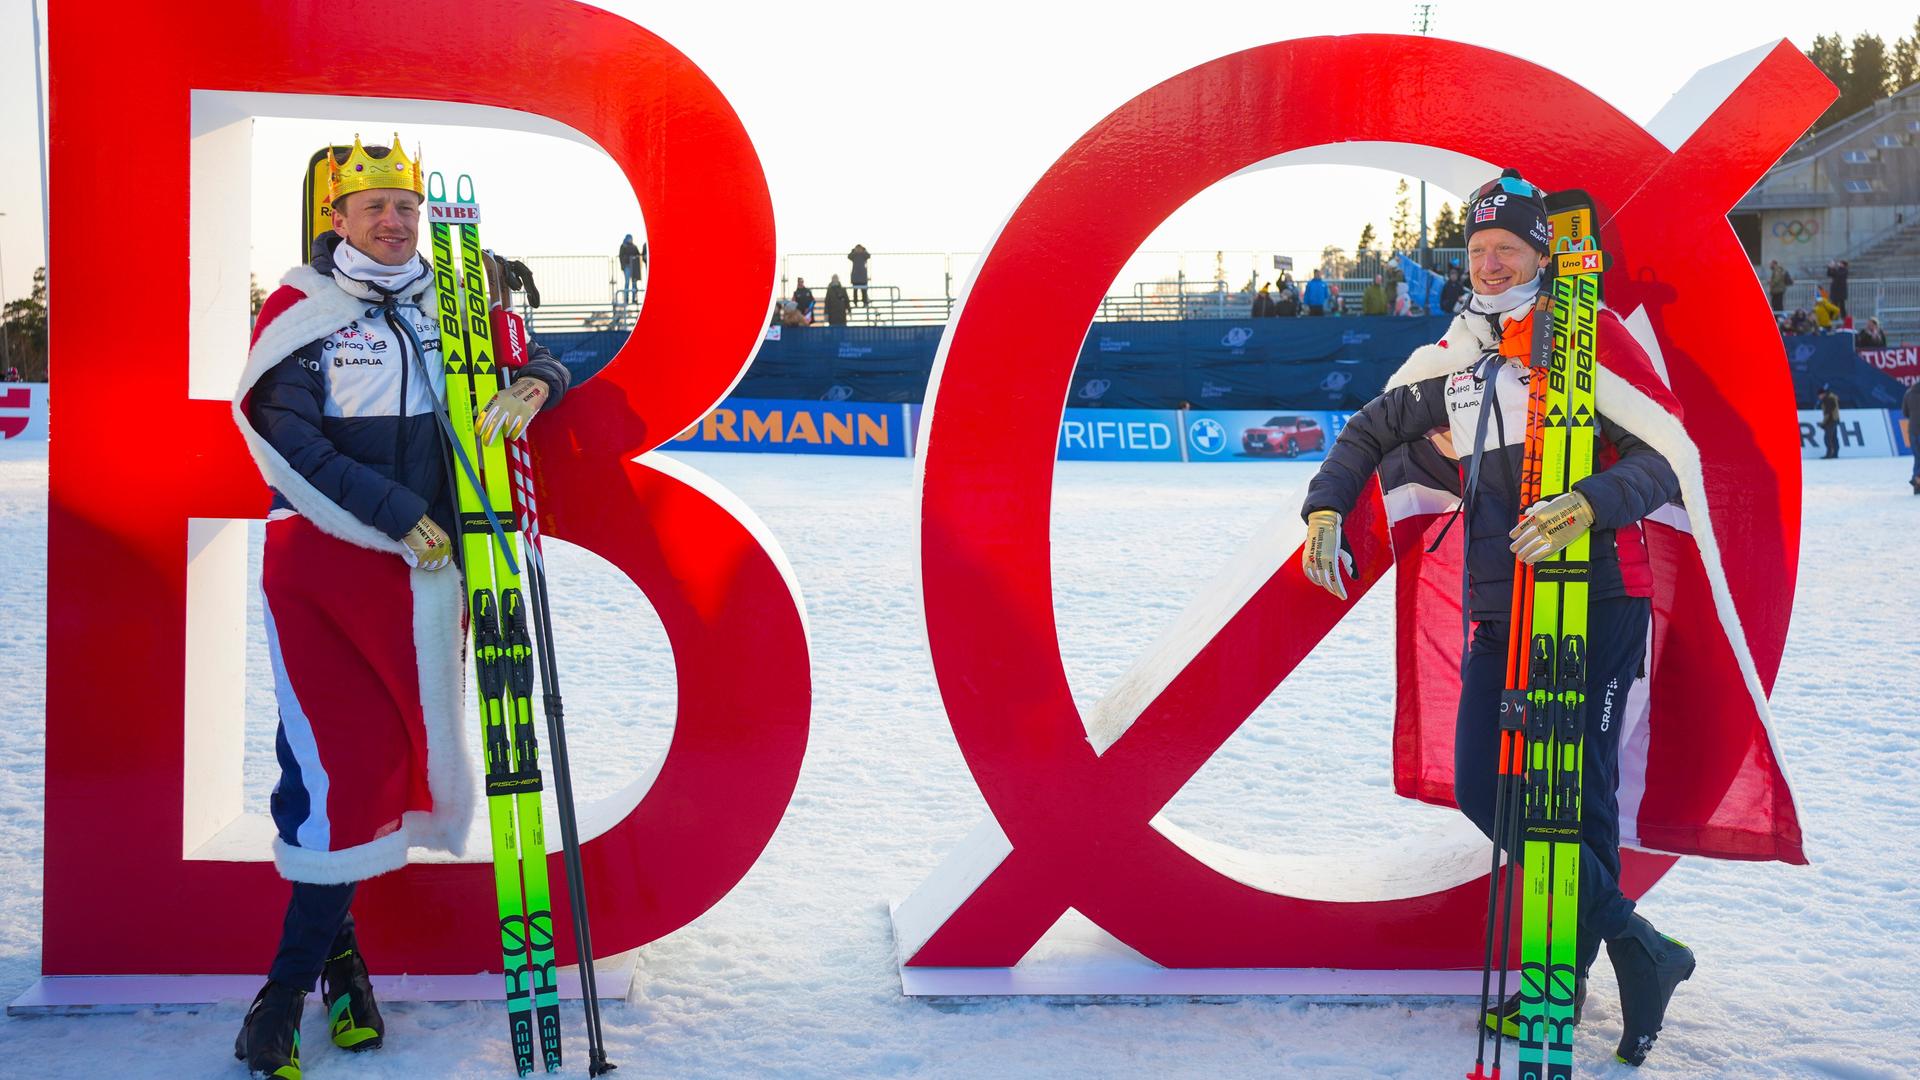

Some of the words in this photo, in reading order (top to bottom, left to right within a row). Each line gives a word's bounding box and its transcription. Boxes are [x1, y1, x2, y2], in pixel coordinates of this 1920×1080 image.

[431, 206, 479, 219] NIBE
[1571, 215, 1581, 239] Uno
[1562, 260, 1581, 269] Uno
[1543, 315, 1551, 338] WAY
[1549, 279, 1571, 395] BØDIUM
[1576, 278, 1595, 395] BØDIUM
[345, 358, 383, 366] LAPUA
[1541, 344, 1549, 367] ONE
[1861, 347, 1918, 369] TUSEN
[1600, 689, 1615, 732] CRAFT
[489, 777, 540, 788] FISCHER
[1526, 826, 1579, 835] FISCHER
